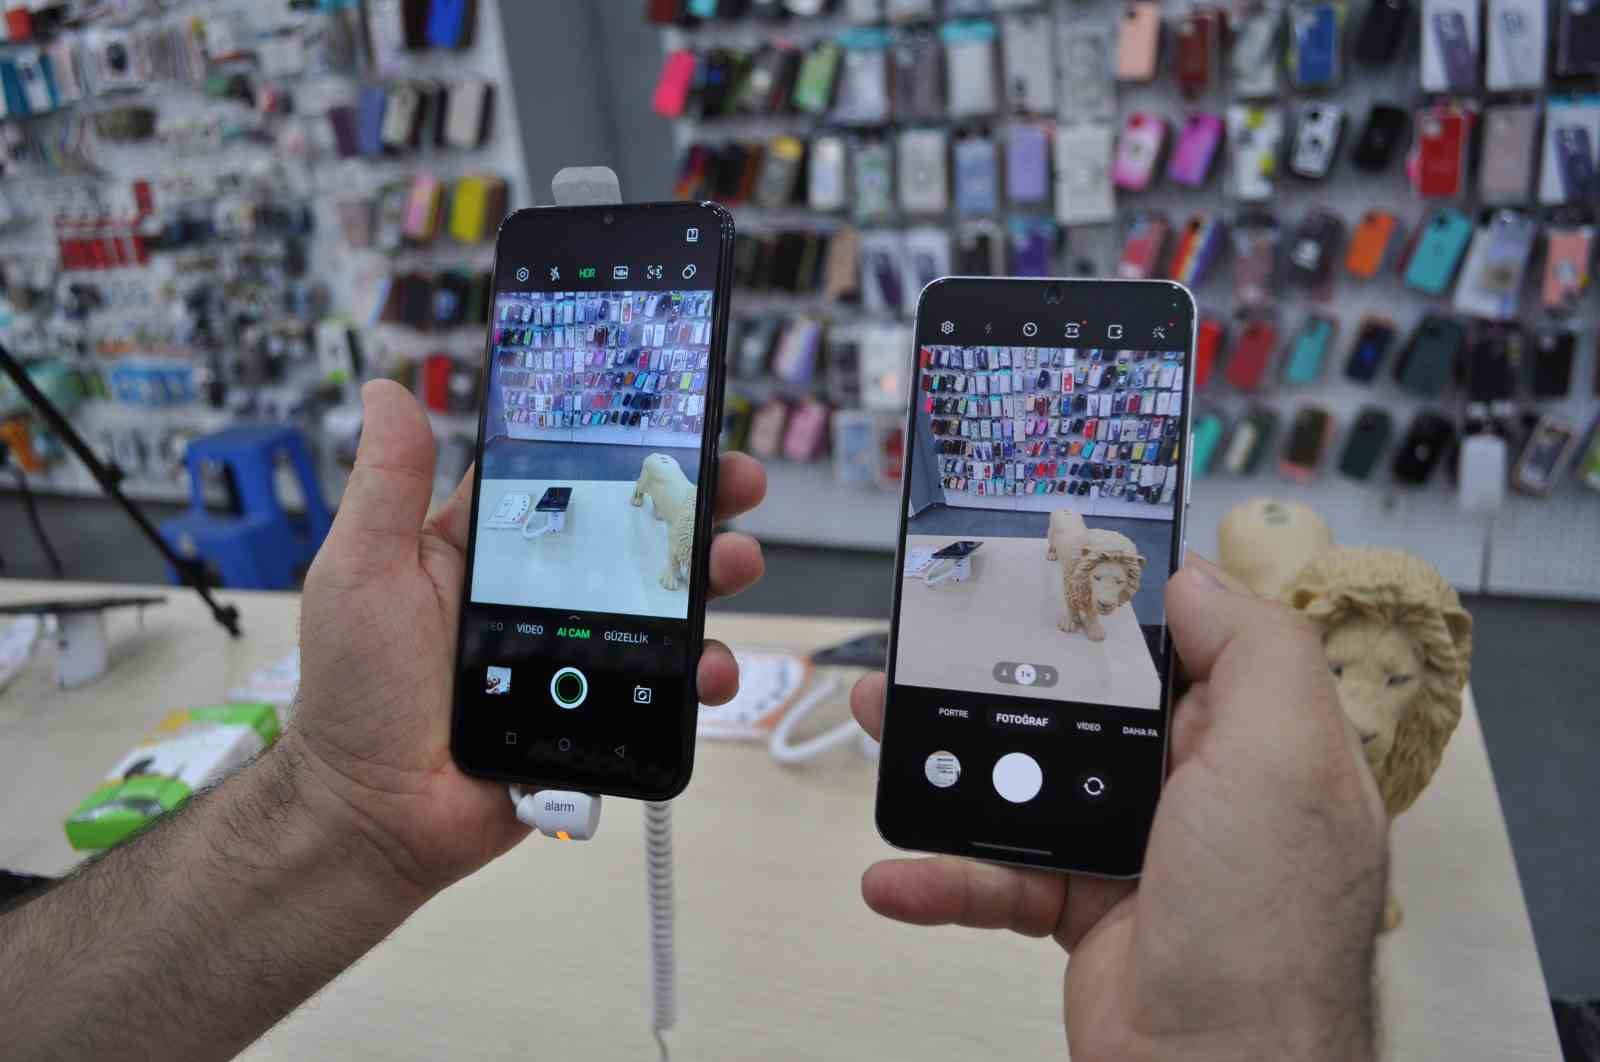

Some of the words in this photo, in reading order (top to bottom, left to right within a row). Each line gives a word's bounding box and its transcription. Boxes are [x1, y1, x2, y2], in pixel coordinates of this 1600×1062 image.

[579, 267, 595, 278] HDR
[556, 627, 567, 637] AI
[568, 627, 590, 639] CAM
[604, 630, 648, 645] GÜZELLİK
[938, 707, 969, 719] PORTRE
[996, 712, 1049, 728] FOTOĞRAF
[1122, 726, 1147, 736] DAHA
[545, 800, 575, 813] alarm
